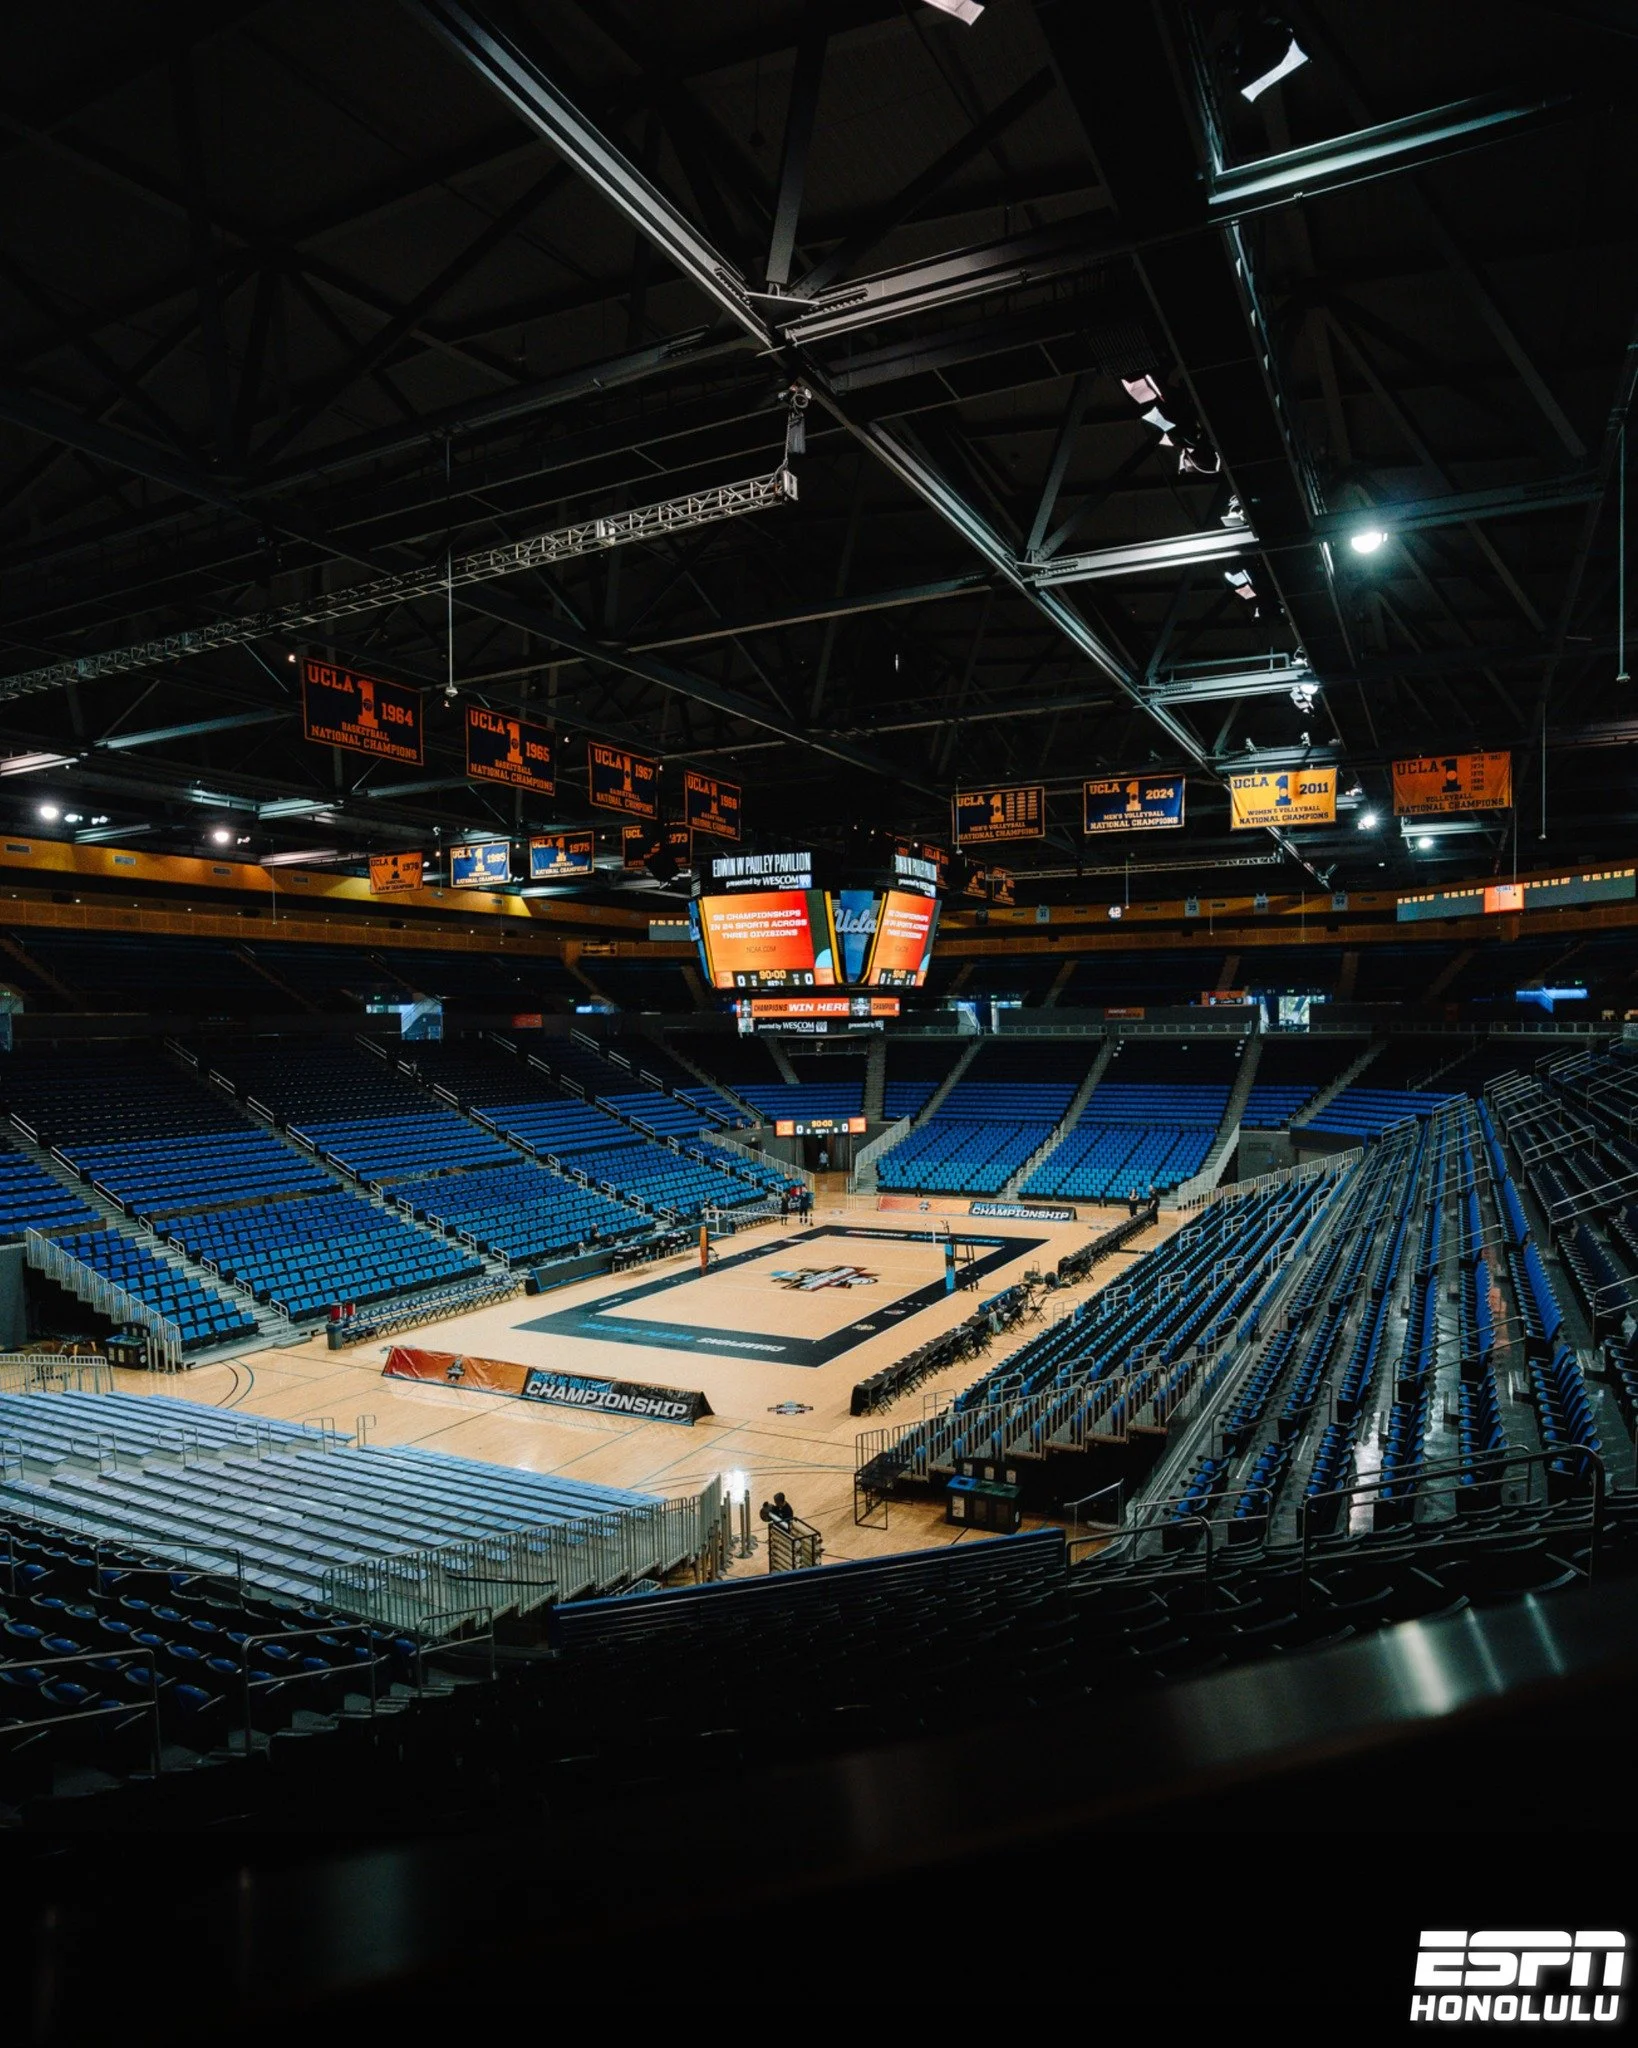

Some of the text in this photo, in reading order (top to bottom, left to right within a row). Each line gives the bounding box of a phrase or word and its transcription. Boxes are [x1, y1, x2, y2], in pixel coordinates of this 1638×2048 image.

[307, 664, 355, 694] UCLA
[381, 702, 414, 728] 1964
[470, 710, 505, 735] UCLA
[342, 721, 390, 742] BASKETBALL
[311, 725, 418, 761] NATIONAL CHAMPIONS
[526, 741, 550, 763] 1965
[594, 748, 623, 770] UCLA
[495, 759, 533, 777] BASKETBALL
[635, 763, 654, 781] 1967
[1396, 761, 1439, 776] UCLA
[471, 762, 553, 792] NATIONAL CHAMPIONS
[1233, 777, 1269, 789] UCLA
[687, 775, 710, 795] UCLA
[1089, 783, 1121, 795] UCLA
[1299, 783, 1329, 795] 2011
[1145, 788, 1175, 801] 2024
[1426, 793, 1473, 803] VOLLEYBALL
[957, 795, 985, 808] UCLA
[1397, 797, 1505, 814] NATIONAL CHAMPIONS
[1103, 810, 1165, 821] MEN'S VOLLEYBALL
[1239, 812, 1329, 825] NATIONAL CHAMPIONS
[1090, 817, 1179, 830] NATIONAL CHAMPIONS
[625, 829, 645, 840] UCL
[668, 832, 689, 845] 973
[995, 827, 1039, 838] CHAMPIONS
[531, 838, 554, 849] UCLA
[569, 842, 590, 854] 1975
[370, 858, 389, 867] UCLA
[712, 852, 811, 878] EDWIN W PAULEY PAVILION
[726, 875, 800, 889] presented by WESCOM
[726, 909, 802, 920] CHAMPIONSHIPS
[835, 909, 877, 933] Ucla
[735, 921, 770, 930] SPORTS
[770, 918, 808, 928] ACROSS
[722, 928, 798, 940] THREE DIVISIONS
[736, 975, 746, 987] 0
[804, 972, 815, 986] 0
[753, 1002, 850, 1012] CHAMPIONS WIN HERE
[782, 1021, 815, 1030] WESCOM
[796, 1124, 804, 1135] 0
[972, 1207, 1070, 1221] CHAMPIONSHIP
[526, 1381, 688, 1418] CHAMPIONSHIP
